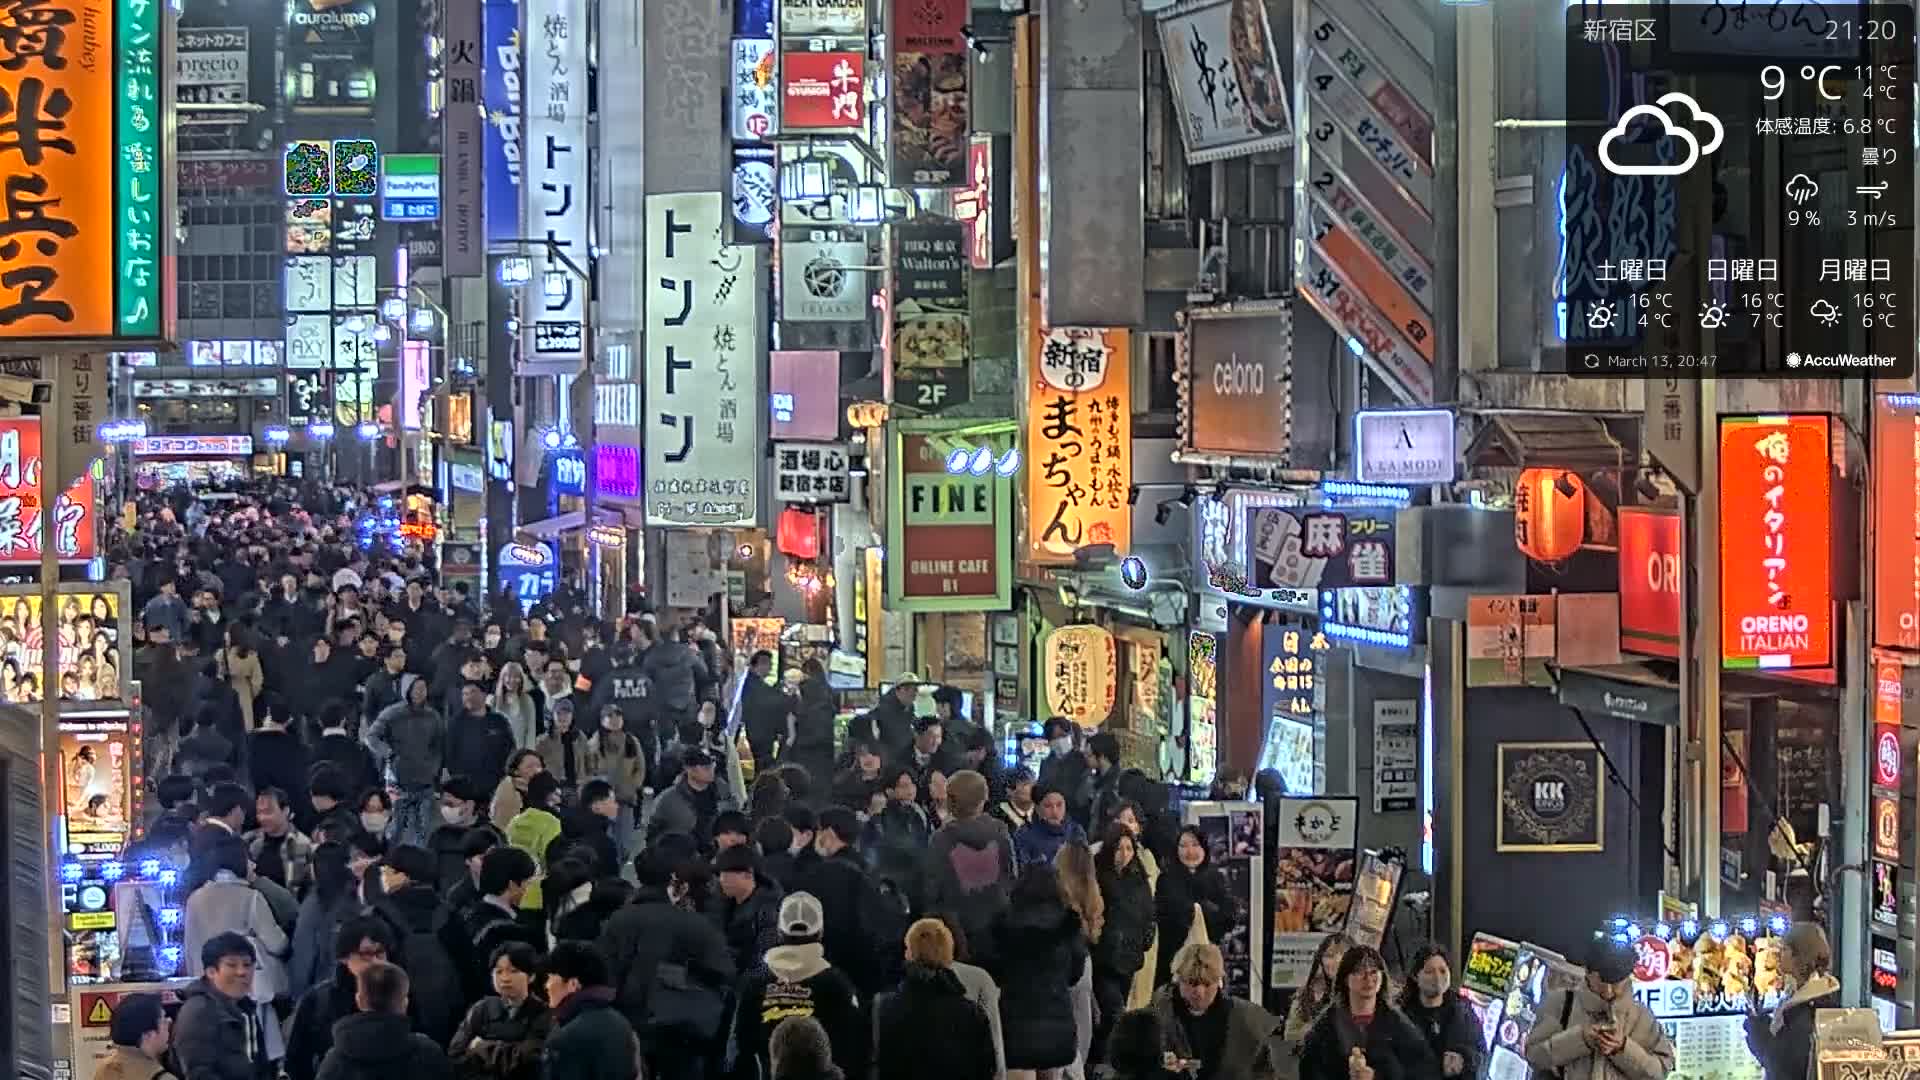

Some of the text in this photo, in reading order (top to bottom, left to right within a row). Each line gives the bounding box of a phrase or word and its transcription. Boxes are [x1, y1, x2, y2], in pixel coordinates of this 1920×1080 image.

[1314, 21, 1336, 42] 5
[451, 40, 475, 103] 火鍋
[1314, 74, 1334, 91] 4
[1314, 122, 1335, 142] 3
[1313, 172, 1335, 193] 2
[660, 208, 693, 463] トントン
[71, 352, 93, 444] 通り一番街
[918, 385, 948, 404] 2F
[779, 449, 843, 471] 酒場心
[1042, 395, 1087, 546] まっちゃん
[912, 484, 987, 513] FINE
[1351, 518, 1390, 536] フリー
[1754, 430, 1791, 605] 俺のイタリアン
[911, 559, 989, 575] ONLINE CAFE
[1740, 615, 1809, 633] ORENO
[1741, 634, 1809, 651] ITALIAN
[1534, 781, 1565, 800] KK
